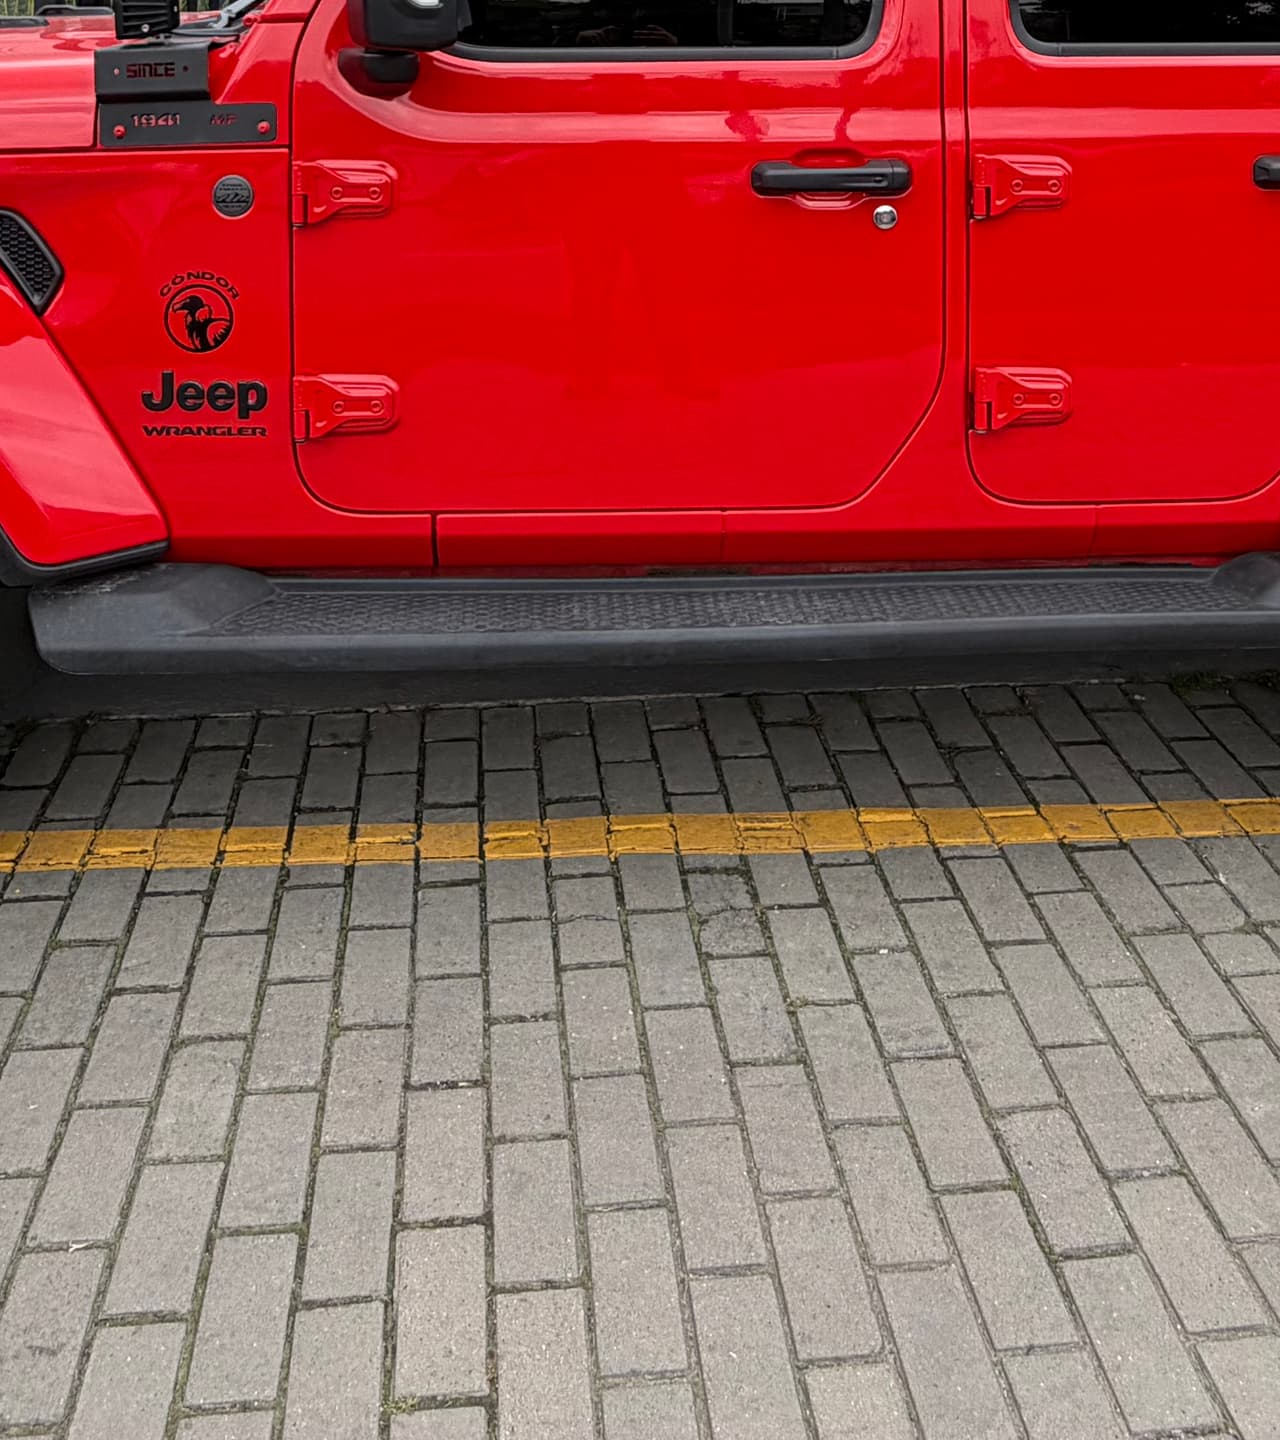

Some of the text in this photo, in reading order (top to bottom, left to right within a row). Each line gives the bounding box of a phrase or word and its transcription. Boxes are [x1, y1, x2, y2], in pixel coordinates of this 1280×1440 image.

[126, 62, 176, 78] SINCE
[141, 369, 269, 421] Jeep
[142, 425, 268, 438] WRANGLER
